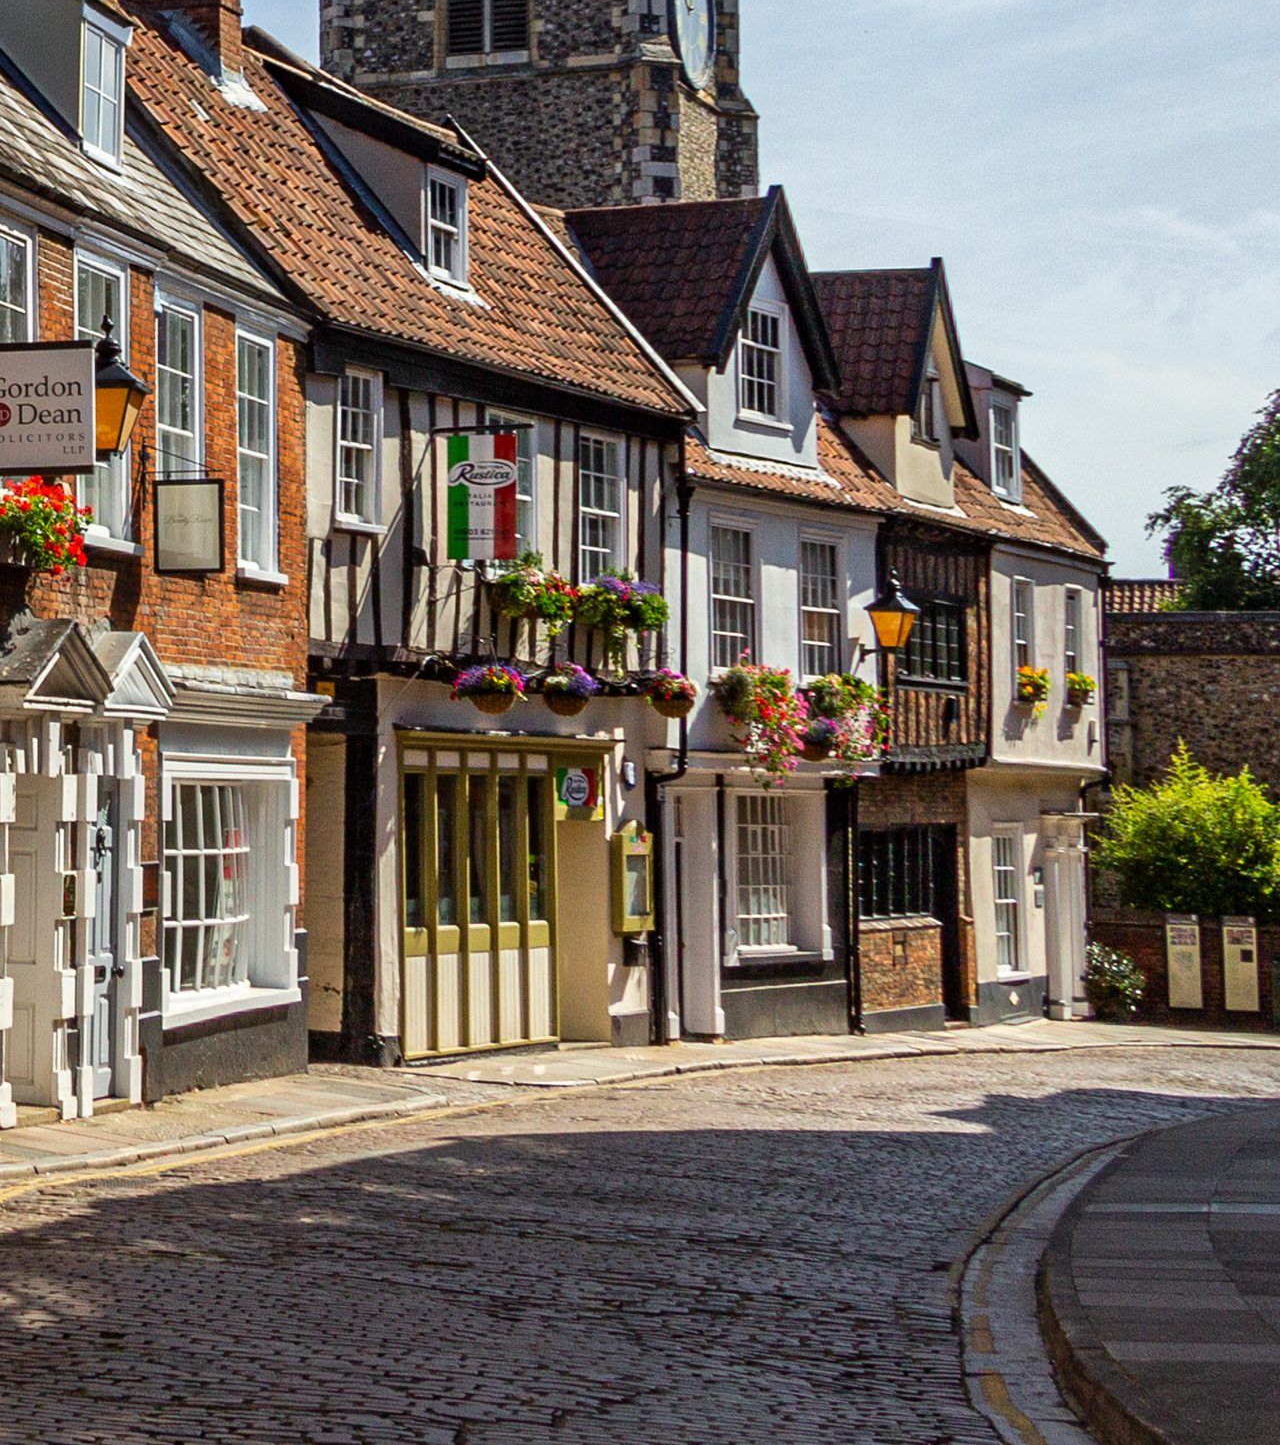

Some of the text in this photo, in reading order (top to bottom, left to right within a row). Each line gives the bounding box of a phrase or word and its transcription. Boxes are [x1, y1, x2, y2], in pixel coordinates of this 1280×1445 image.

[16, 403, 83, 425] Dean
[63, 445, 85, 455] LLP
[448, 463, 511, 484] Rustica
